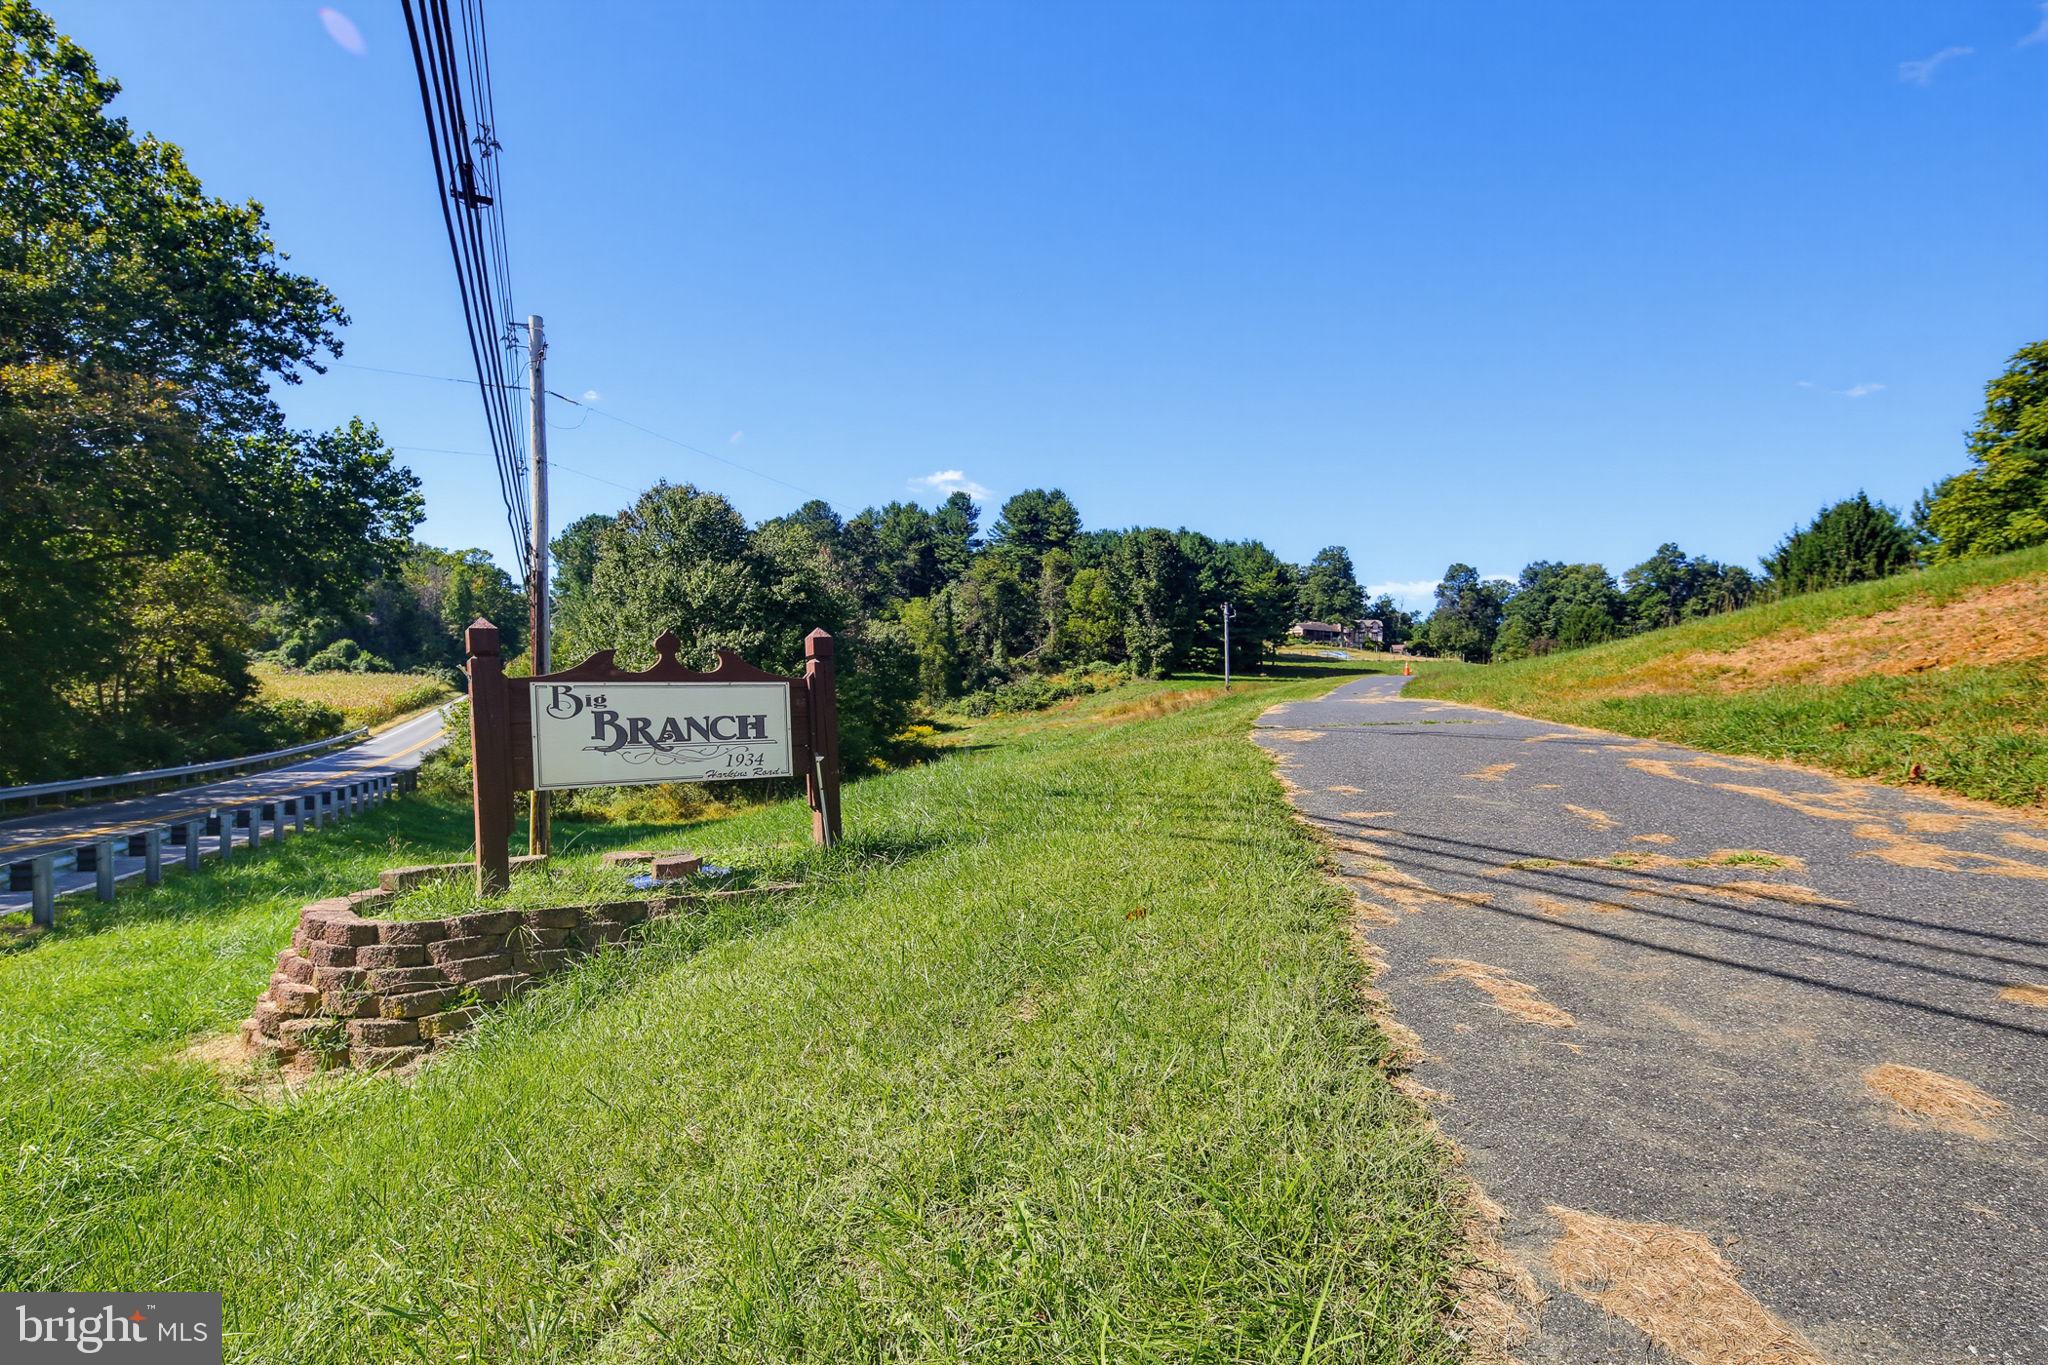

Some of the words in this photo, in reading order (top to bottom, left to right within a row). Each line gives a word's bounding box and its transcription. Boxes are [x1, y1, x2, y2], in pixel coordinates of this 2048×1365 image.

[546, 685, 608, 720] Big
[590, 710, 769, 753] BRANCH
[725, 752, 765, 768] 1934
[704, 769, 748, 779] Harkins
[752, 767, 781, 777] Road
